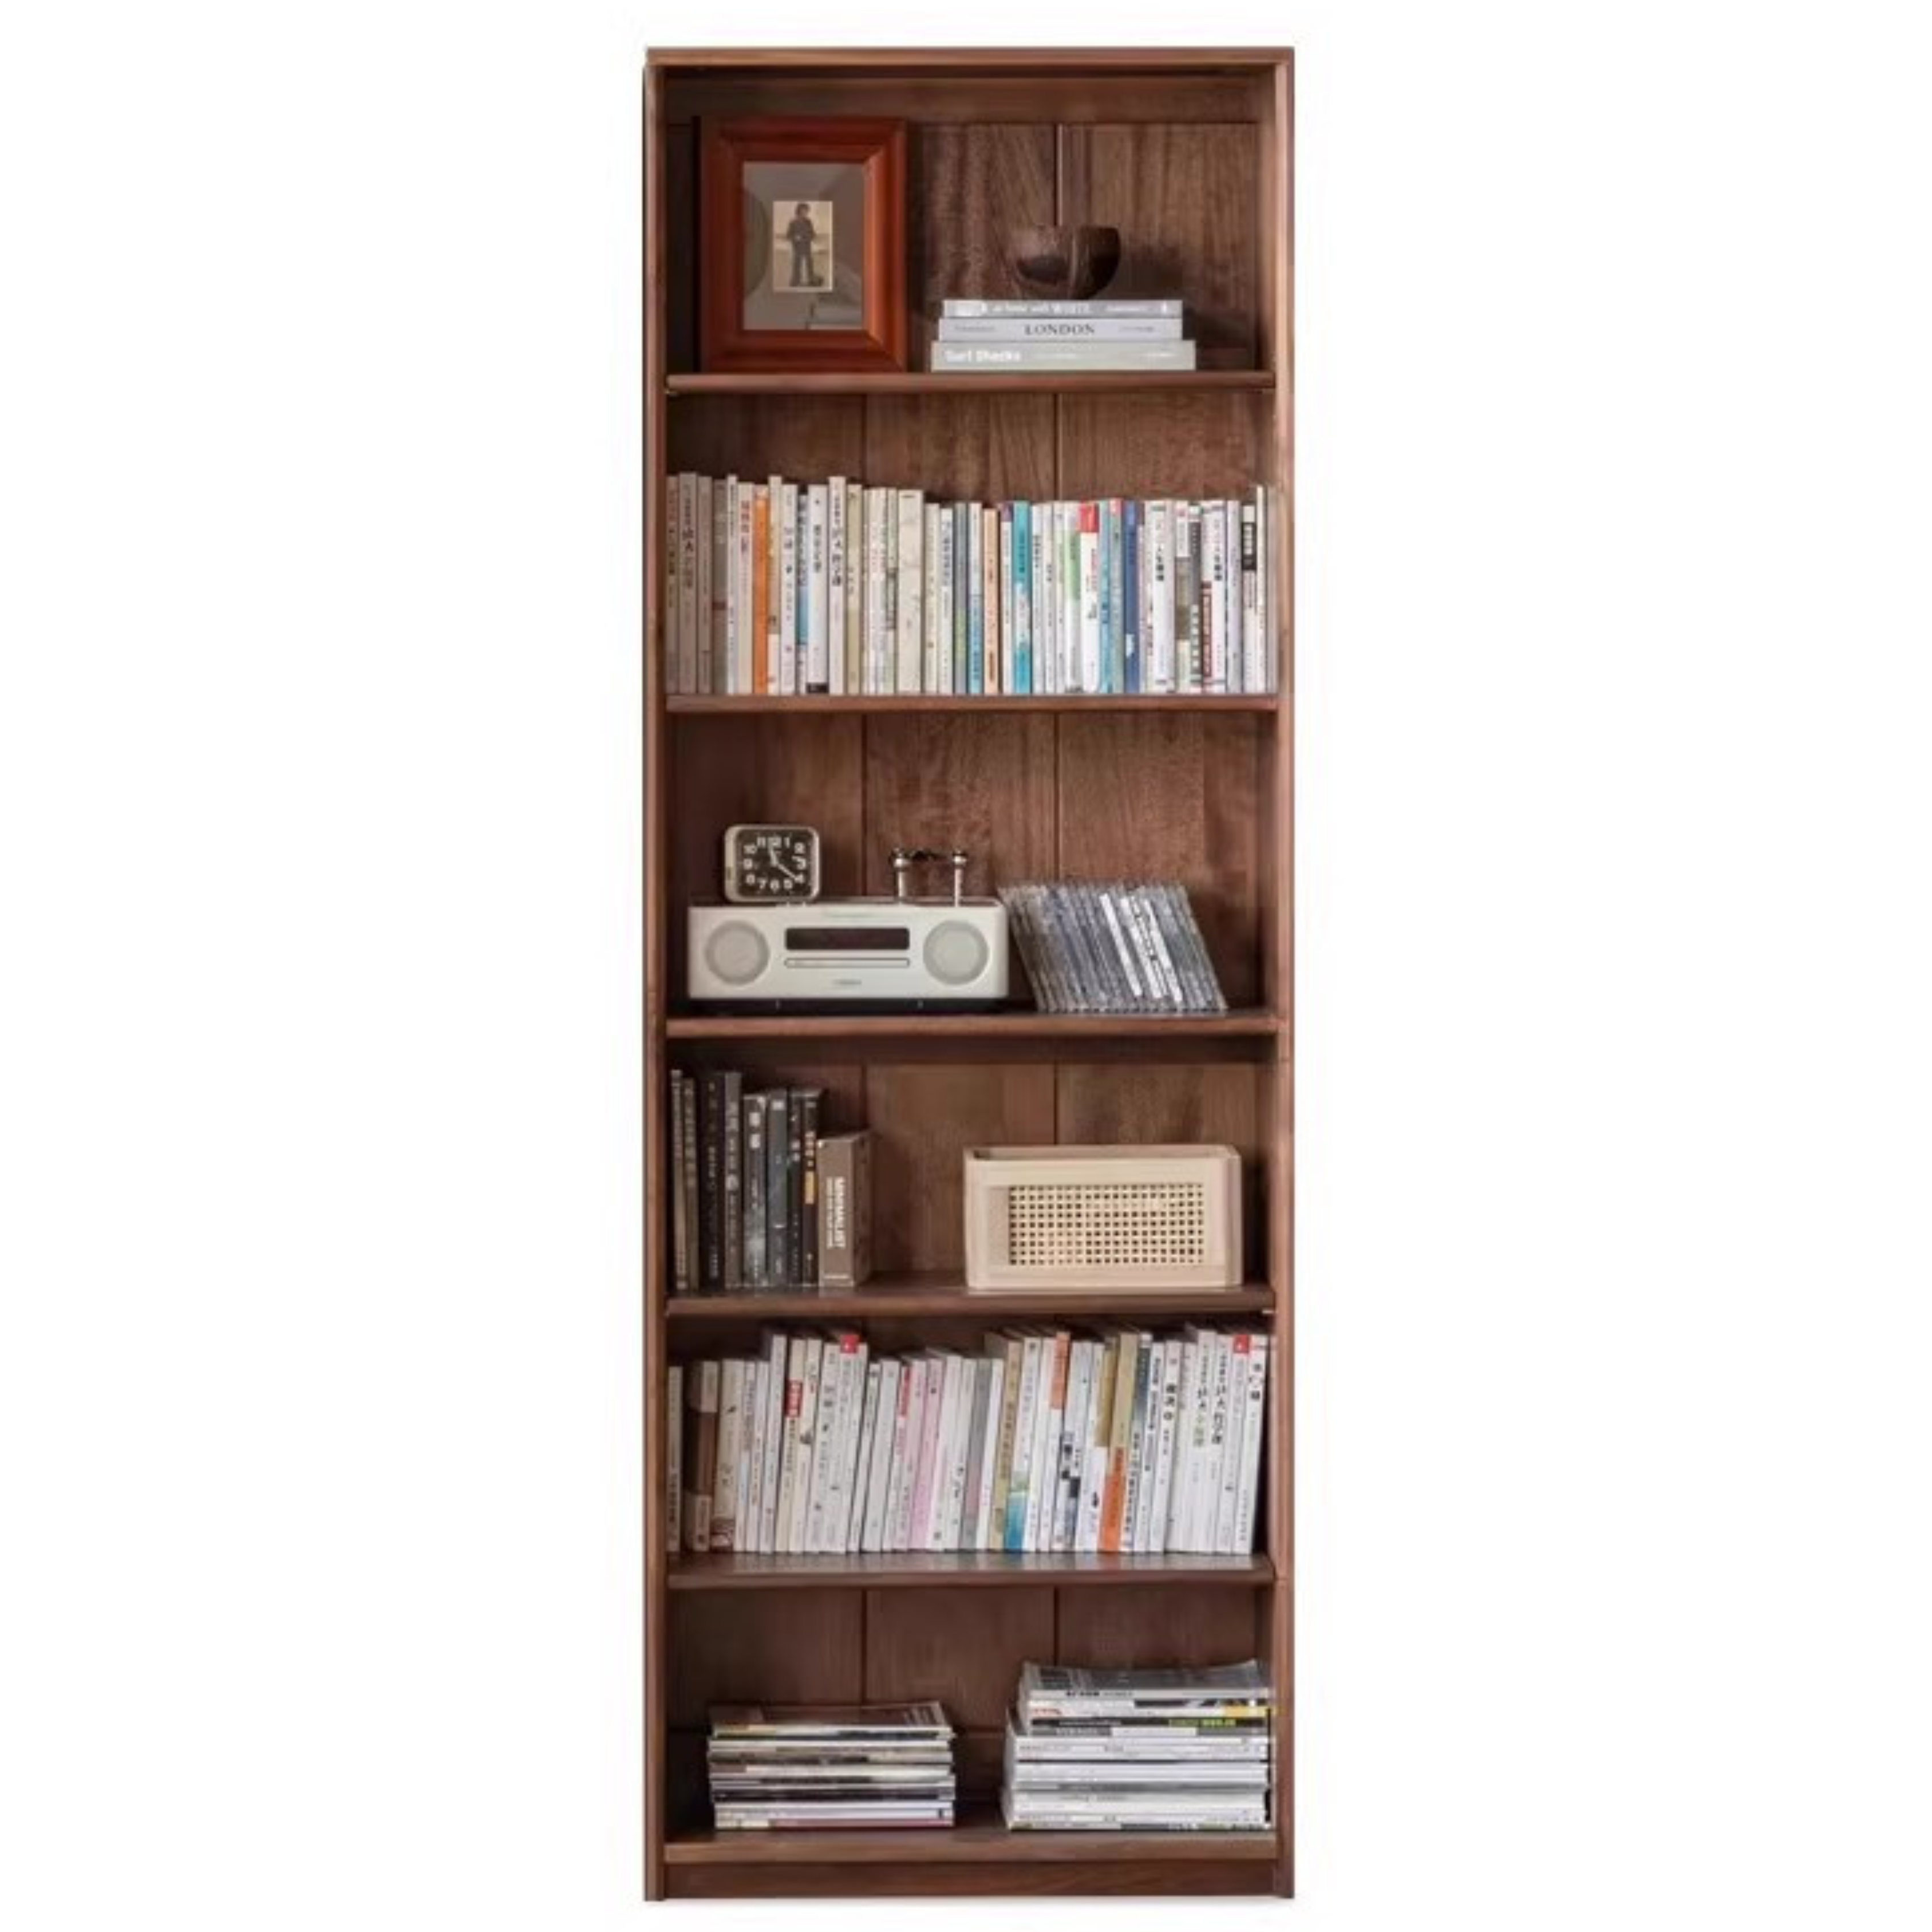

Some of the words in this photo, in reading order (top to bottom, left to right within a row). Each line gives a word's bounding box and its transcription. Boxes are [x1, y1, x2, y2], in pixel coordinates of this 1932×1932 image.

[1024, 325, 1095, 335] LONDON
[783, 836, 789, 848] 1
[794, 842, 805, 854] 2
[744, 844, 757, 855] 10
[792, 855, 806, 870] 3
[757, 877, 768, 890] 7
[833, 1176, 846, 1249] MINIMALIST
